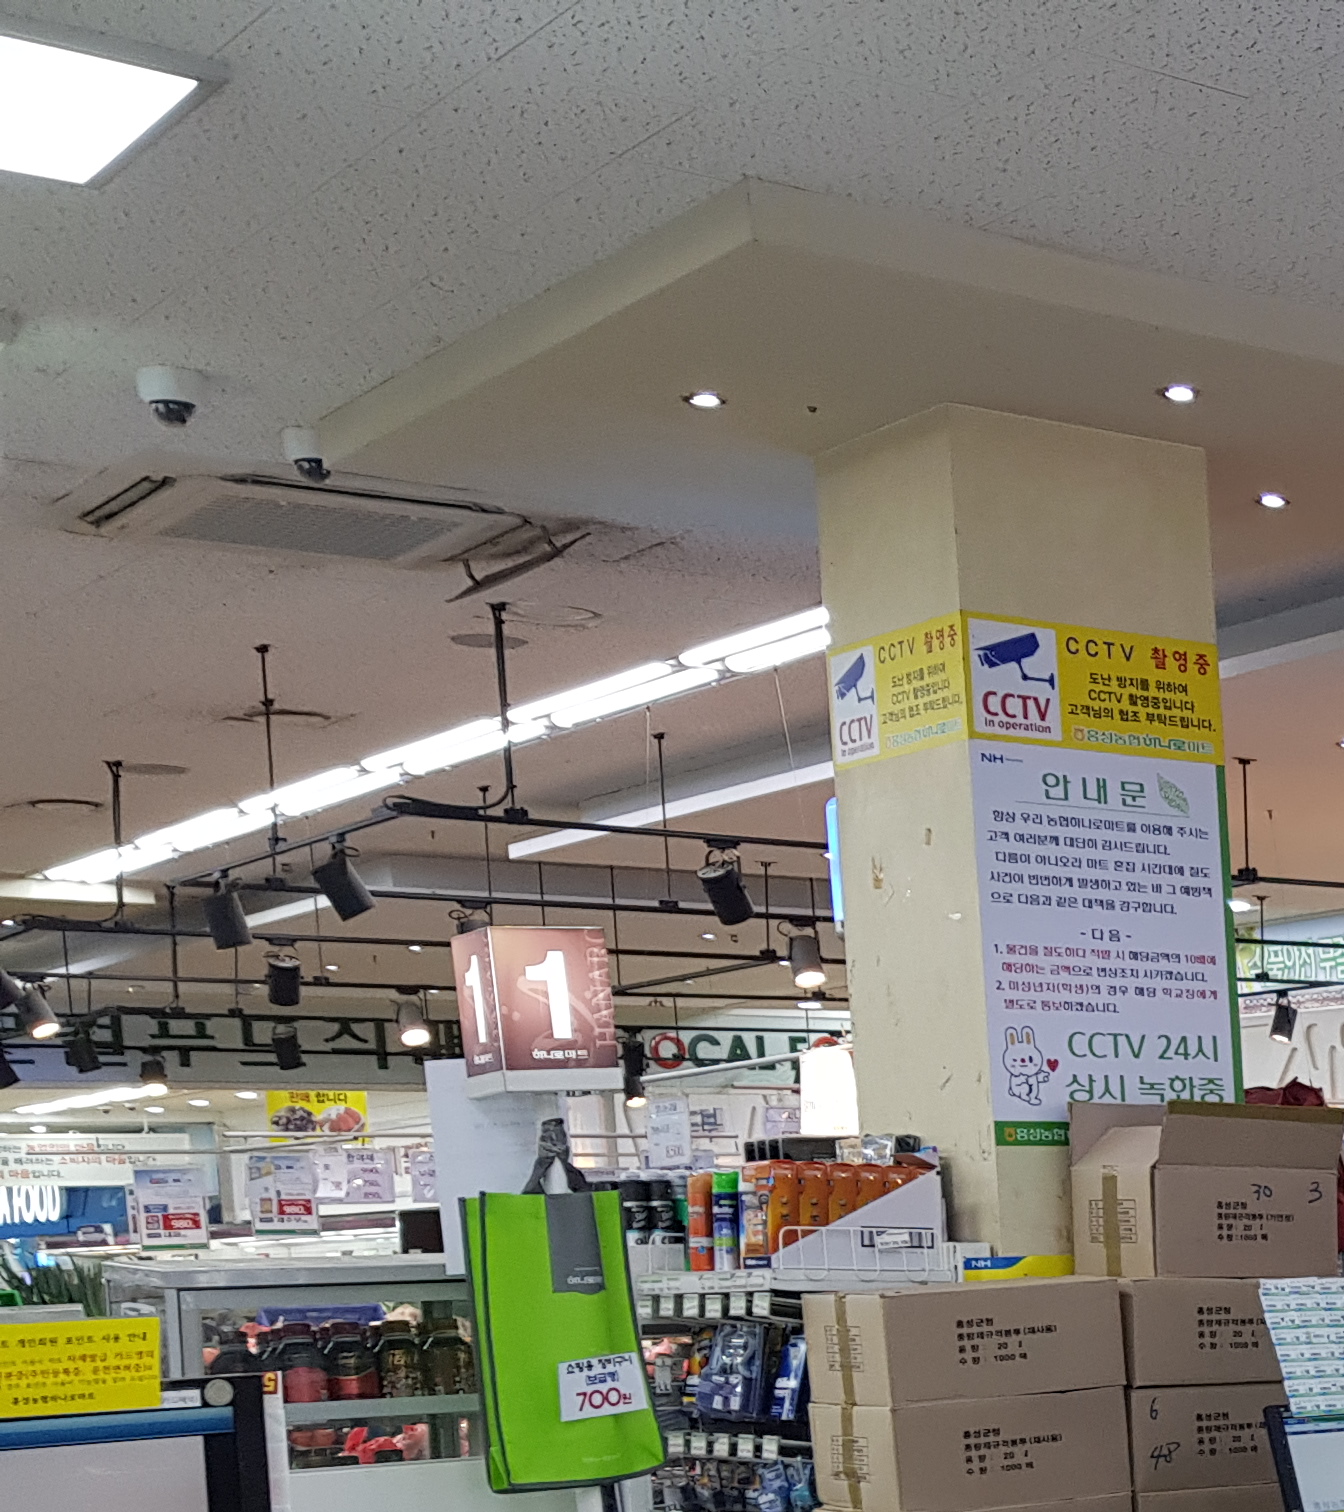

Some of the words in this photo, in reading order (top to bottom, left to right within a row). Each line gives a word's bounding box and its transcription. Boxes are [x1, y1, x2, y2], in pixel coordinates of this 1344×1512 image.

[878, 637, 915, 664] CCTV
[924, 624, 957, 654] 촬영중
[1066, 637, 1134, 662] CCTV
[1150, 646, 1210, 675] 촬영중
[1089, 673, 1111, 689] 도난
[1116, 676, 1150, 692] 방지를
[1155, 680, 1188, 696] 위하여
[982, 691, 1051, 721] CCTV
[1088, 689, 1122, 704] CCTV
[1128, 693, 1195, 712] 촬영중입니다
[840, 715, 873, 746] CCTV
[997, 721, 1051, 734] operation
[1068, 703, 1114, 720] 고객님의
[1119, 709, 1140, 725] 협조
[1145, 712, 1216, 733] 부탁드립니다.
[981, 753, 1003, 763] NH
[1020, 813, 1043, 825] 우리
[465, 954, 487, 1043] 1
[524, 950, 573, 1039] 1
[650, 1032, 775, 1070] OCAL
[1067, 1031, 1146, 1059] CCTV
[1157, 1034, 1219, 1062] 24시
[1066, 1073, 1126, 1102] 상시
[1138, 1075, 1225, 1103] 녹화중
[1308, 1181, 1322, 1203] 3
[576, 1387, 632, 1411] 700원
[1150, 1398, 1158, 1420] 6
